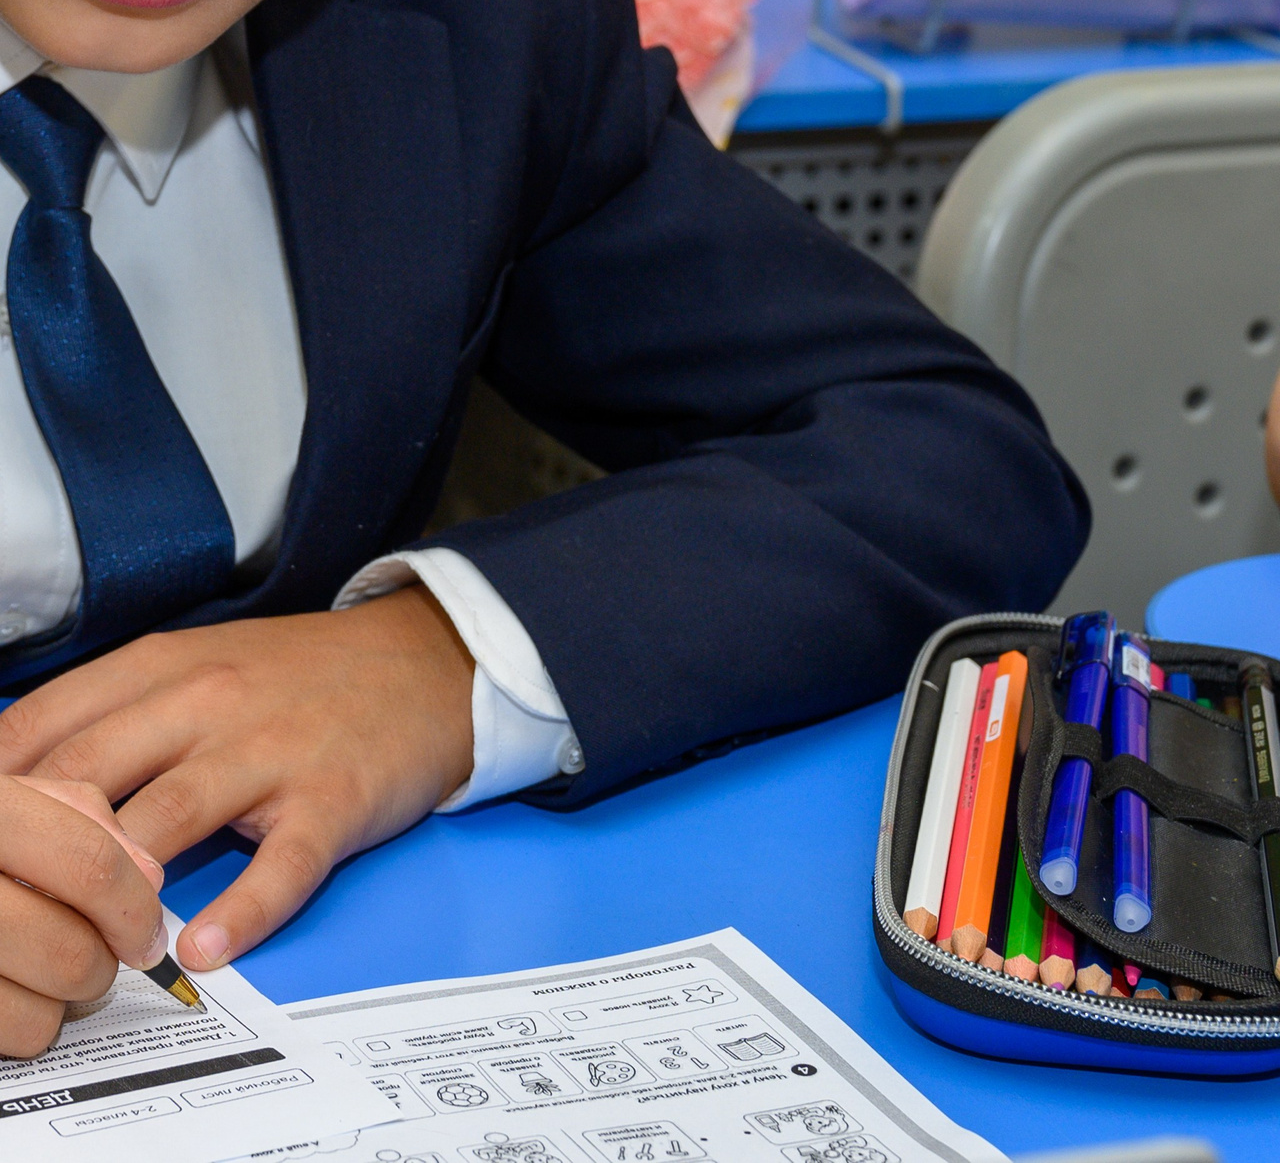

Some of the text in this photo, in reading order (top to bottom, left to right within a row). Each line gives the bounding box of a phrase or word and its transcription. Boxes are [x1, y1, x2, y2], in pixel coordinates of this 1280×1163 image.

[612, 963, 696, 982] Разговоры
[530, 981, 597, 996] важном
[632, 995, 673, 1007] узнавать
[155, 1016, 218, 1032] положил
[172, 1022, 226, 1038] разных
[715, 1023, 748, 1032] читать
[105, 1029, 141, 1041] свою
[126, 1033, 171, 1046] новых
[176, 1032, 223, 1047] Давай
[463, 1032, 486, 1040] буду
[536, 1035, 575, 1044] Выбери
[46, 1037, 104, 1053] корзину
[642, 1037, 680, 1046] считать
[74, 1042, 124, 1058] знаний
[85, 1042, 173, 1063] представим,
[559, 1047, 607, 1057] создавать
[36, 1054, 72, 1065] этим
[490, 1057, 532, 1067] природе
[571, 1051, 616, 1062] рисовать
[60, 1061, 84, 1069] что
[798, 1066, 809, 1074] 4
[421, 1067, 462, 1078] спортом
[753, 1074, 787, 1083] Чему
[200, 1075, 299, 1100] Рабочий лист
[711, 1081, 739, 1091] хочу
[2, 1090, 74, 1112] ДЕНЬ
[637, 1087, 708, 1104] научиться?
[75, 1111, 128, 1127] классы
